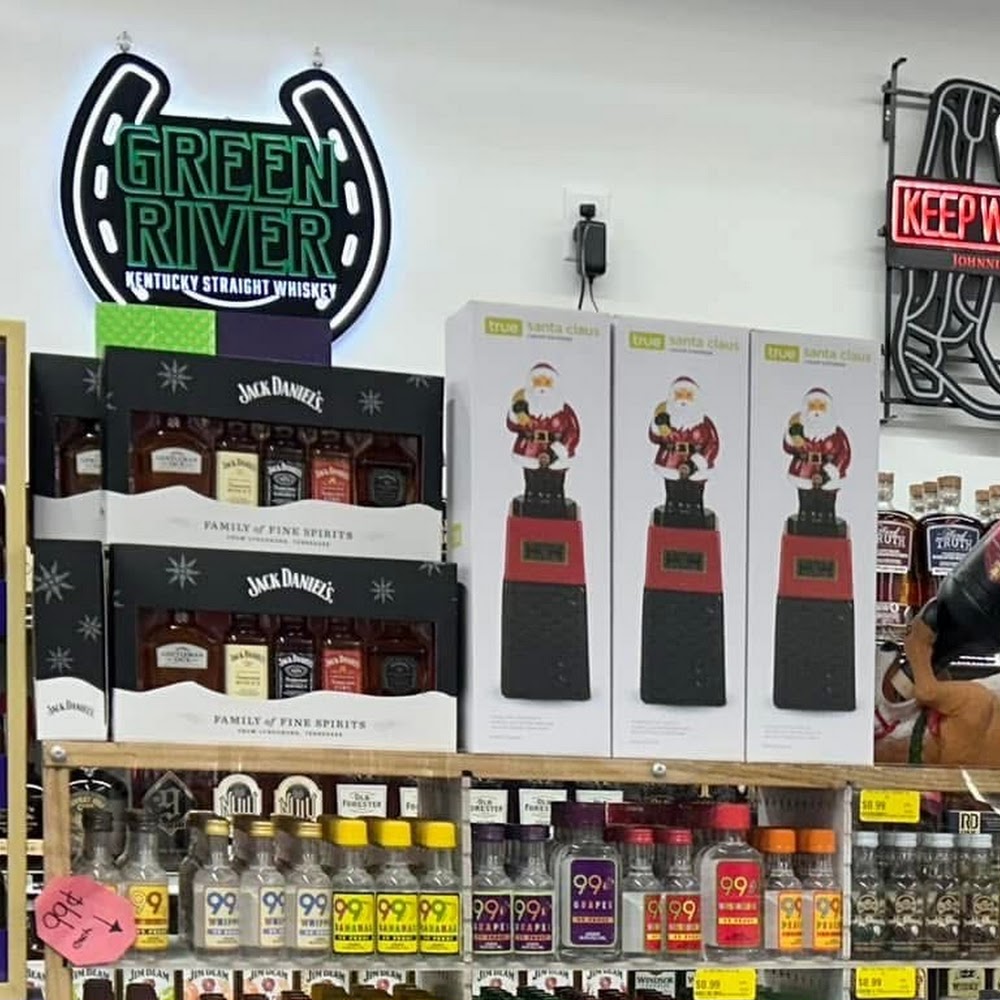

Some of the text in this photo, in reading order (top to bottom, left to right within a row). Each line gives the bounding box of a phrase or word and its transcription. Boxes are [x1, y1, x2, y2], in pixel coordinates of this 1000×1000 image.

[114, 126, 339, 208] GREEN
[903, 188, 977, 240] KEEP
[124, 197, 338, 279] RIVER
[125, 271, 337, 300] KENTUCKY STRAIGHT WHISKEY
[488, 319, 599, 337] true santa claus
[632, 335, 739, 351] true santa claus
[767, 346, 797, 362] true
[804, 347, 837, 361] santa
[839, 349, 872, 364] claus
[238, 375, 324, 413] JACK DANIEL'S
[203, 520, 354, 541] FAMILY of FINE SPIRITS
[935, 535, 973, 552] TRUTH
[247, 567, 334, 604] JACK DANIEL'S
[213, 714, 367, 731] FAMILY of FINE SPIRITS
[573, 874, 602, 896] 99
[720, 875, 748, 897] 99
[207, 892, 237, 915] 99
[299, 893, 328, 916] 99
